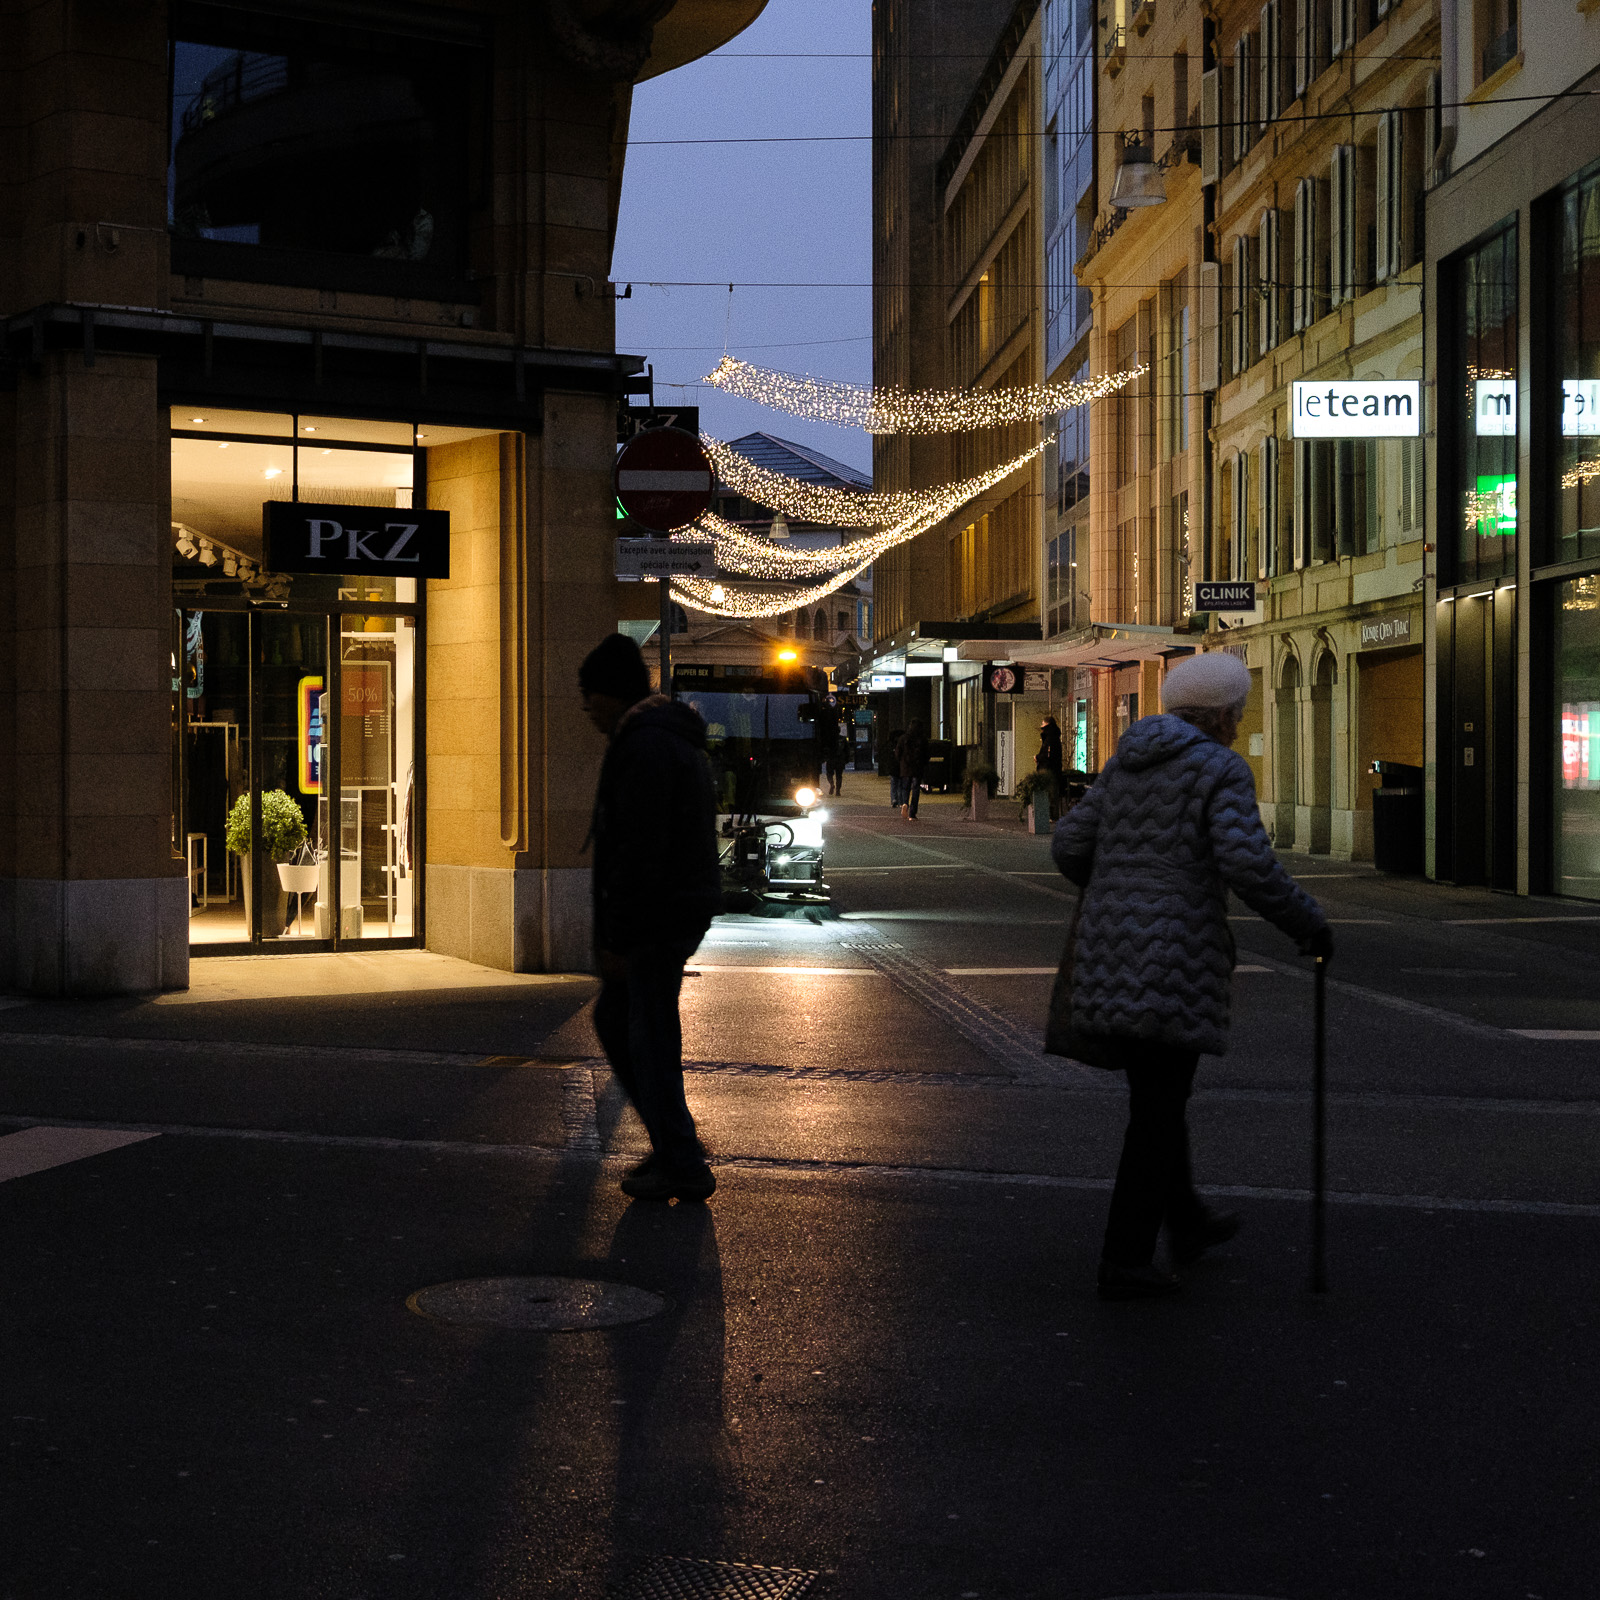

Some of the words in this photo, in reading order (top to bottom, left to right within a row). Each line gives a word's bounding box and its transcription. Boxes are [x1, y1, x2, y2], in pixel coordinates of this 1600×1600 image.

[304, 518, 421, 563] PKZ
[620, 546, 648, 556] Excepté
[650, 547, 666, 555] avec
[668, 546, 713, 555] autorisation
[640, 561, 669, 571] spéciale
[671, 561, 691, 570] écrite
[1200, 587, 1250, 600] CLINIK
[1393, 619, 1409, 638] TABAC
[348, 687, 378, 703] 50%
